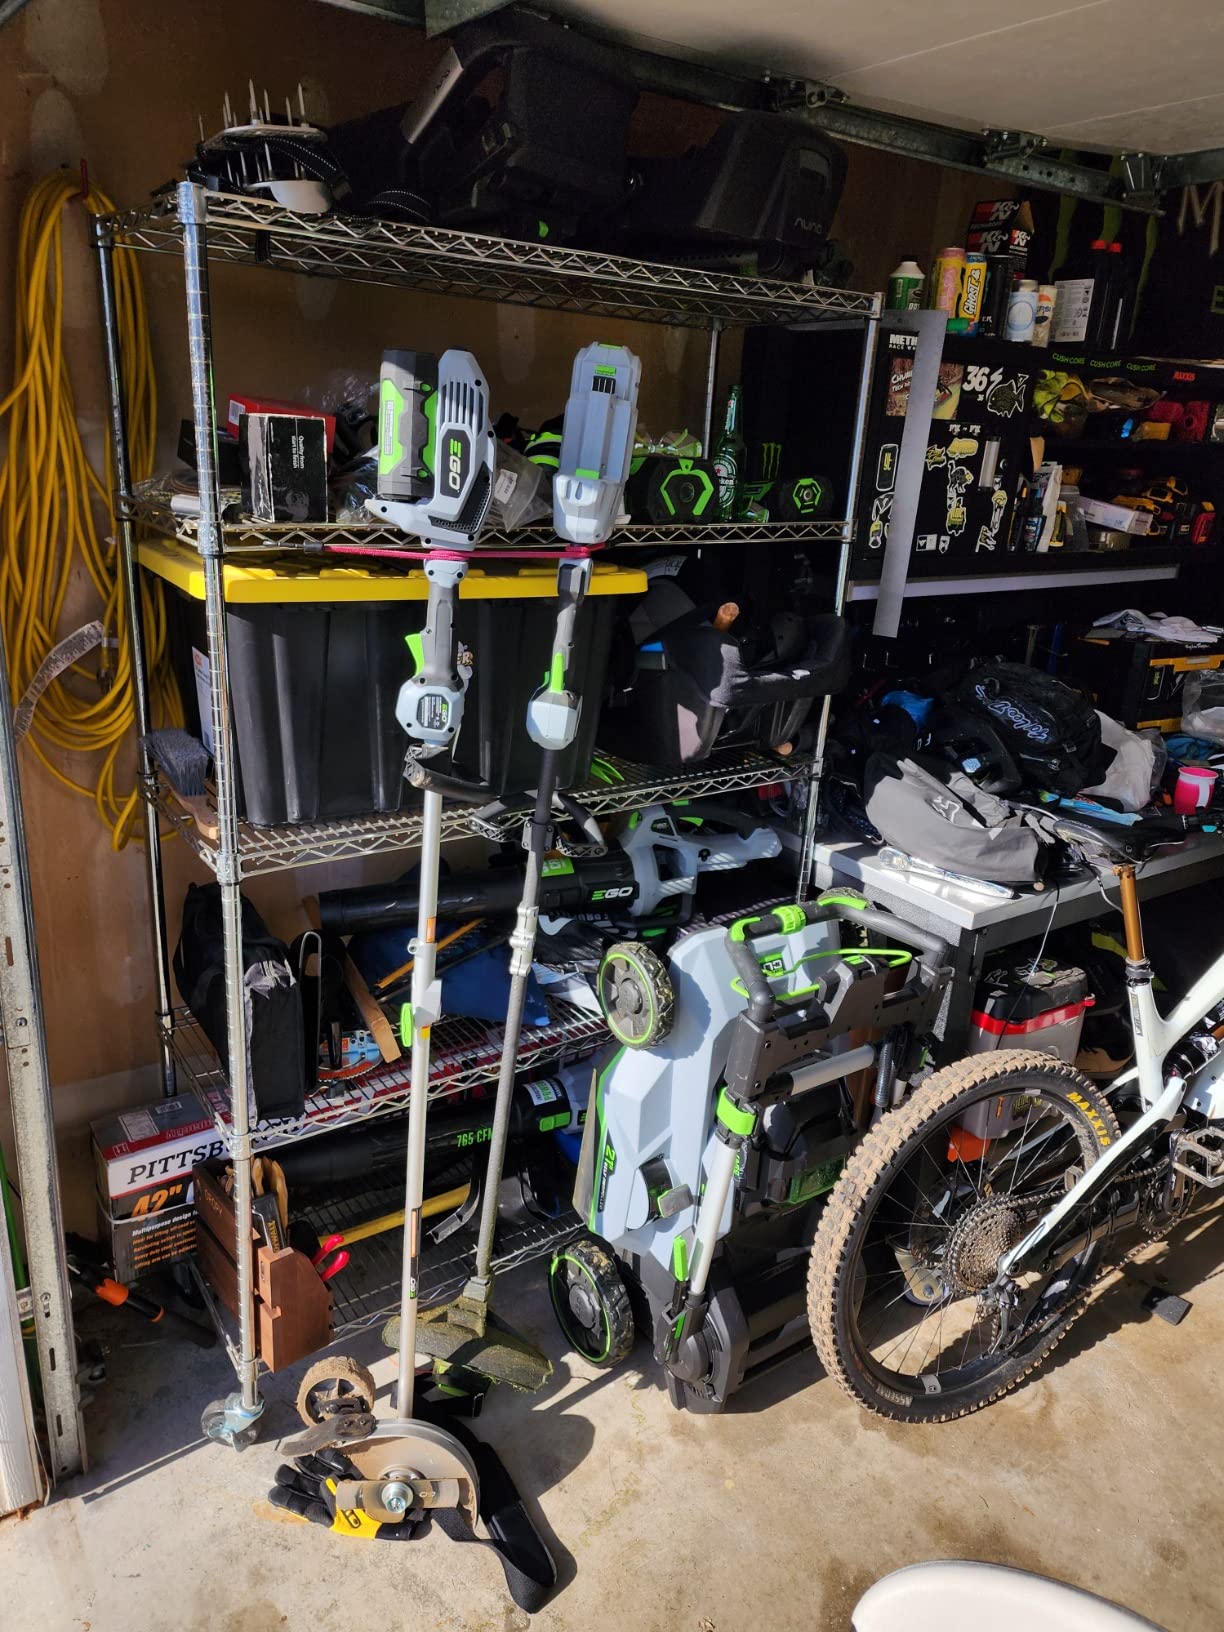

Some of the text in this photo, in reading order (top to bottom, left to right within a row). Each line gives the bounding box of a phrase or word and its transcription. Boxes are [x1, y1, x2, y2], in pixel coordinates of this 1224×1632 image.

[962, 277, 981, 315] GHOST
[889, 334, 917, 346] METH
[449, 438, 462, 489] EGO
[591, 886, 633, 901] EGO
[1065, 1091, 1111, 1146] MAXXIS
[457, 1132, 474, 1148] 765
